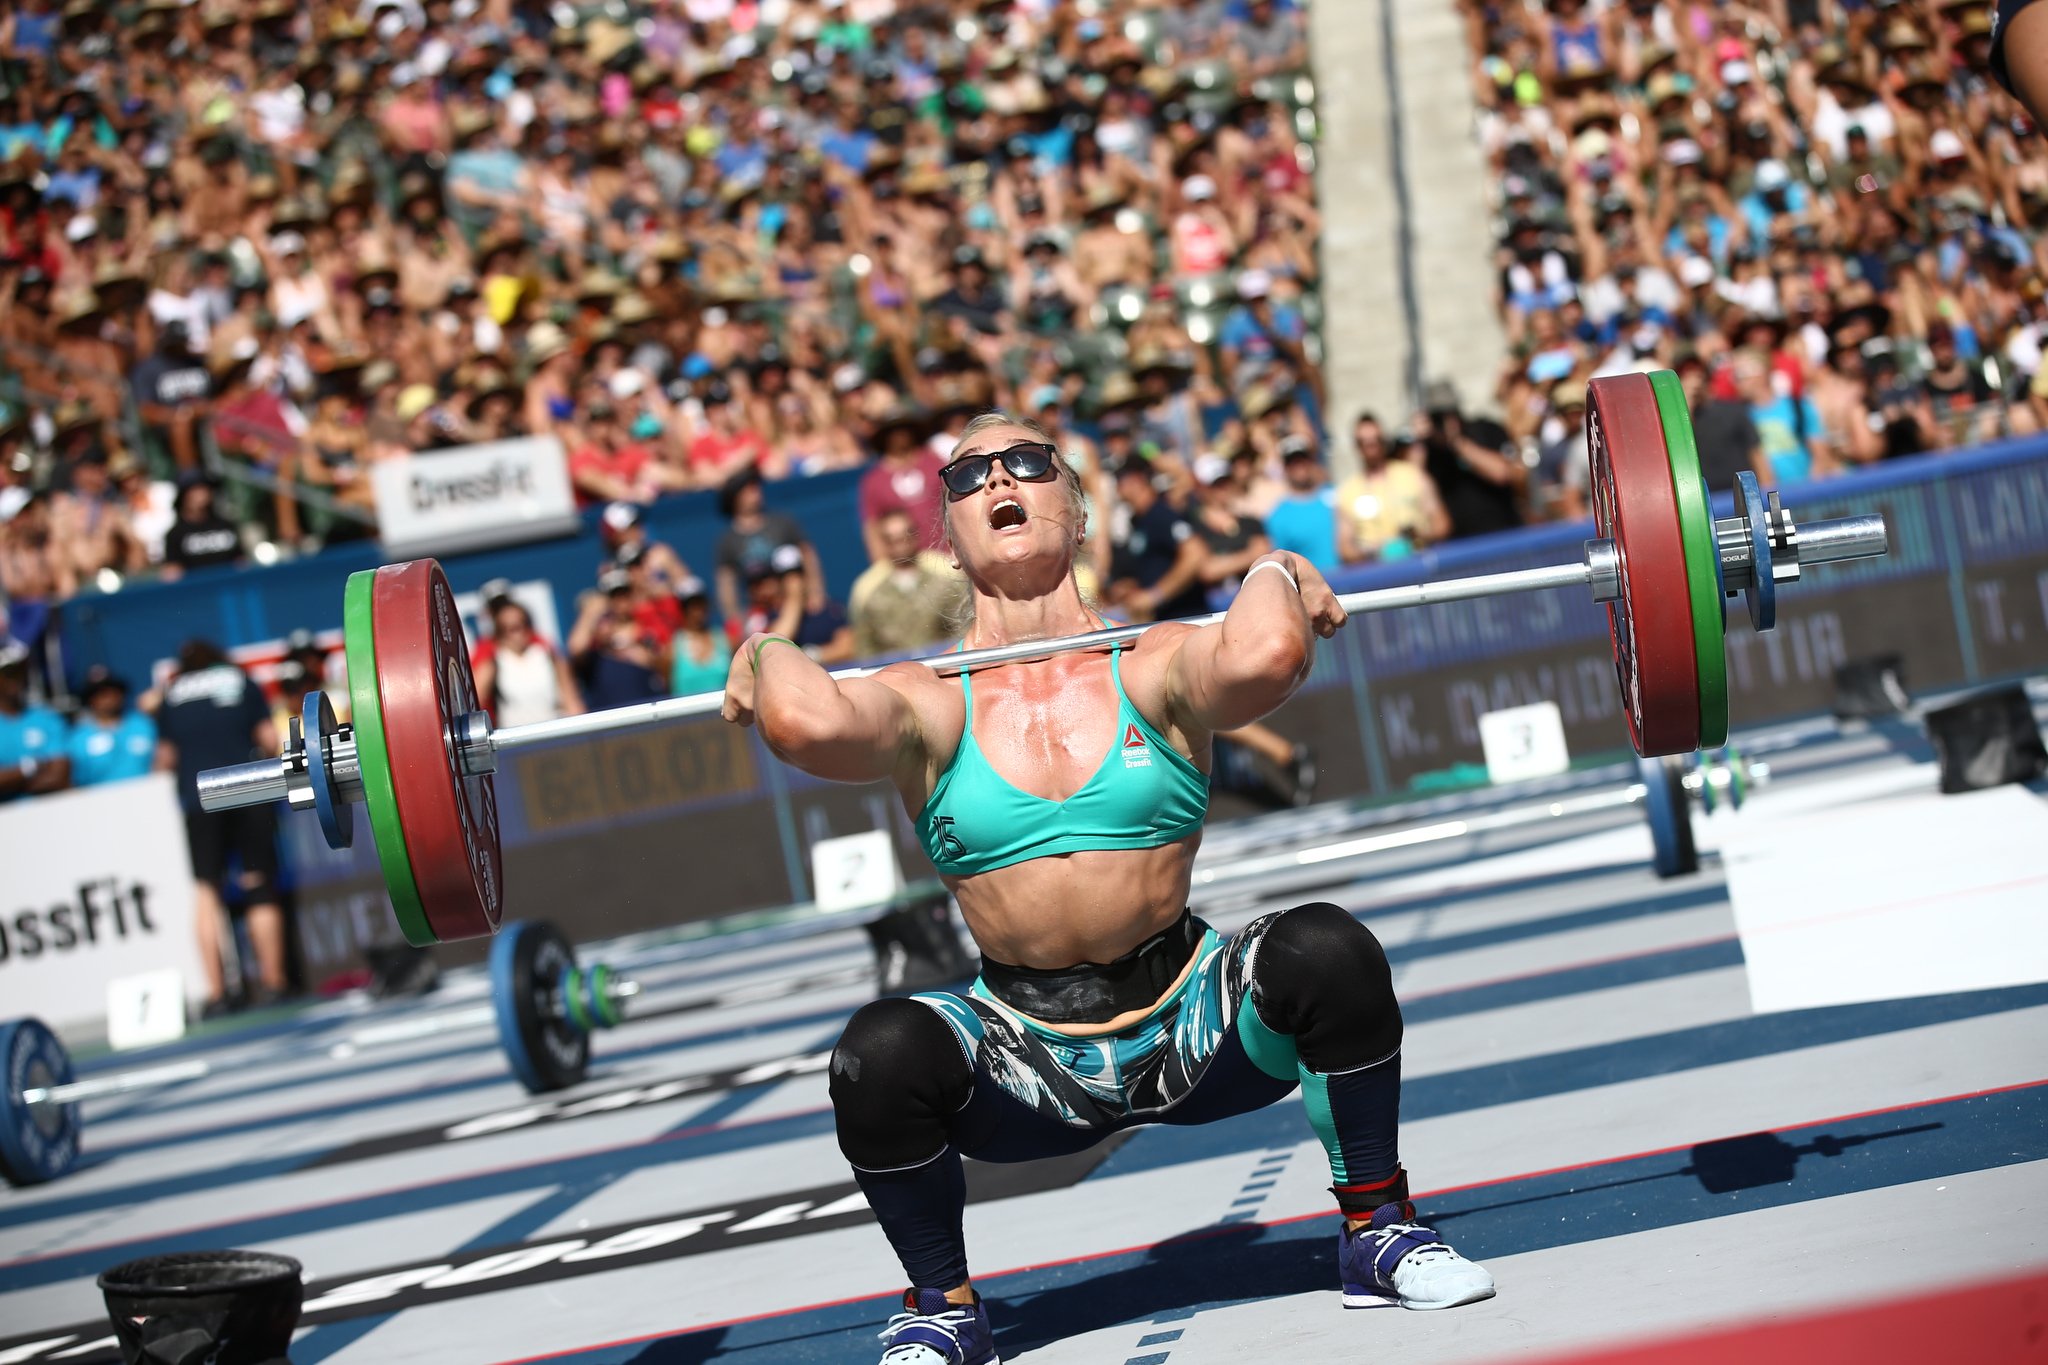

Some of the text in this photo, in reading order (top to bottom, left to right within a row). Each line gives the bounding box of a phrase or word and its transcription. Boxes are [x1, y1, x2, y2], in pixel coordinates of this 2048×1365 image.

[1510, 721, 1536, 762] 3
[1121, 747, 1151, 758] Reebok
[1125, 758, 1152, 769] CrossFit
